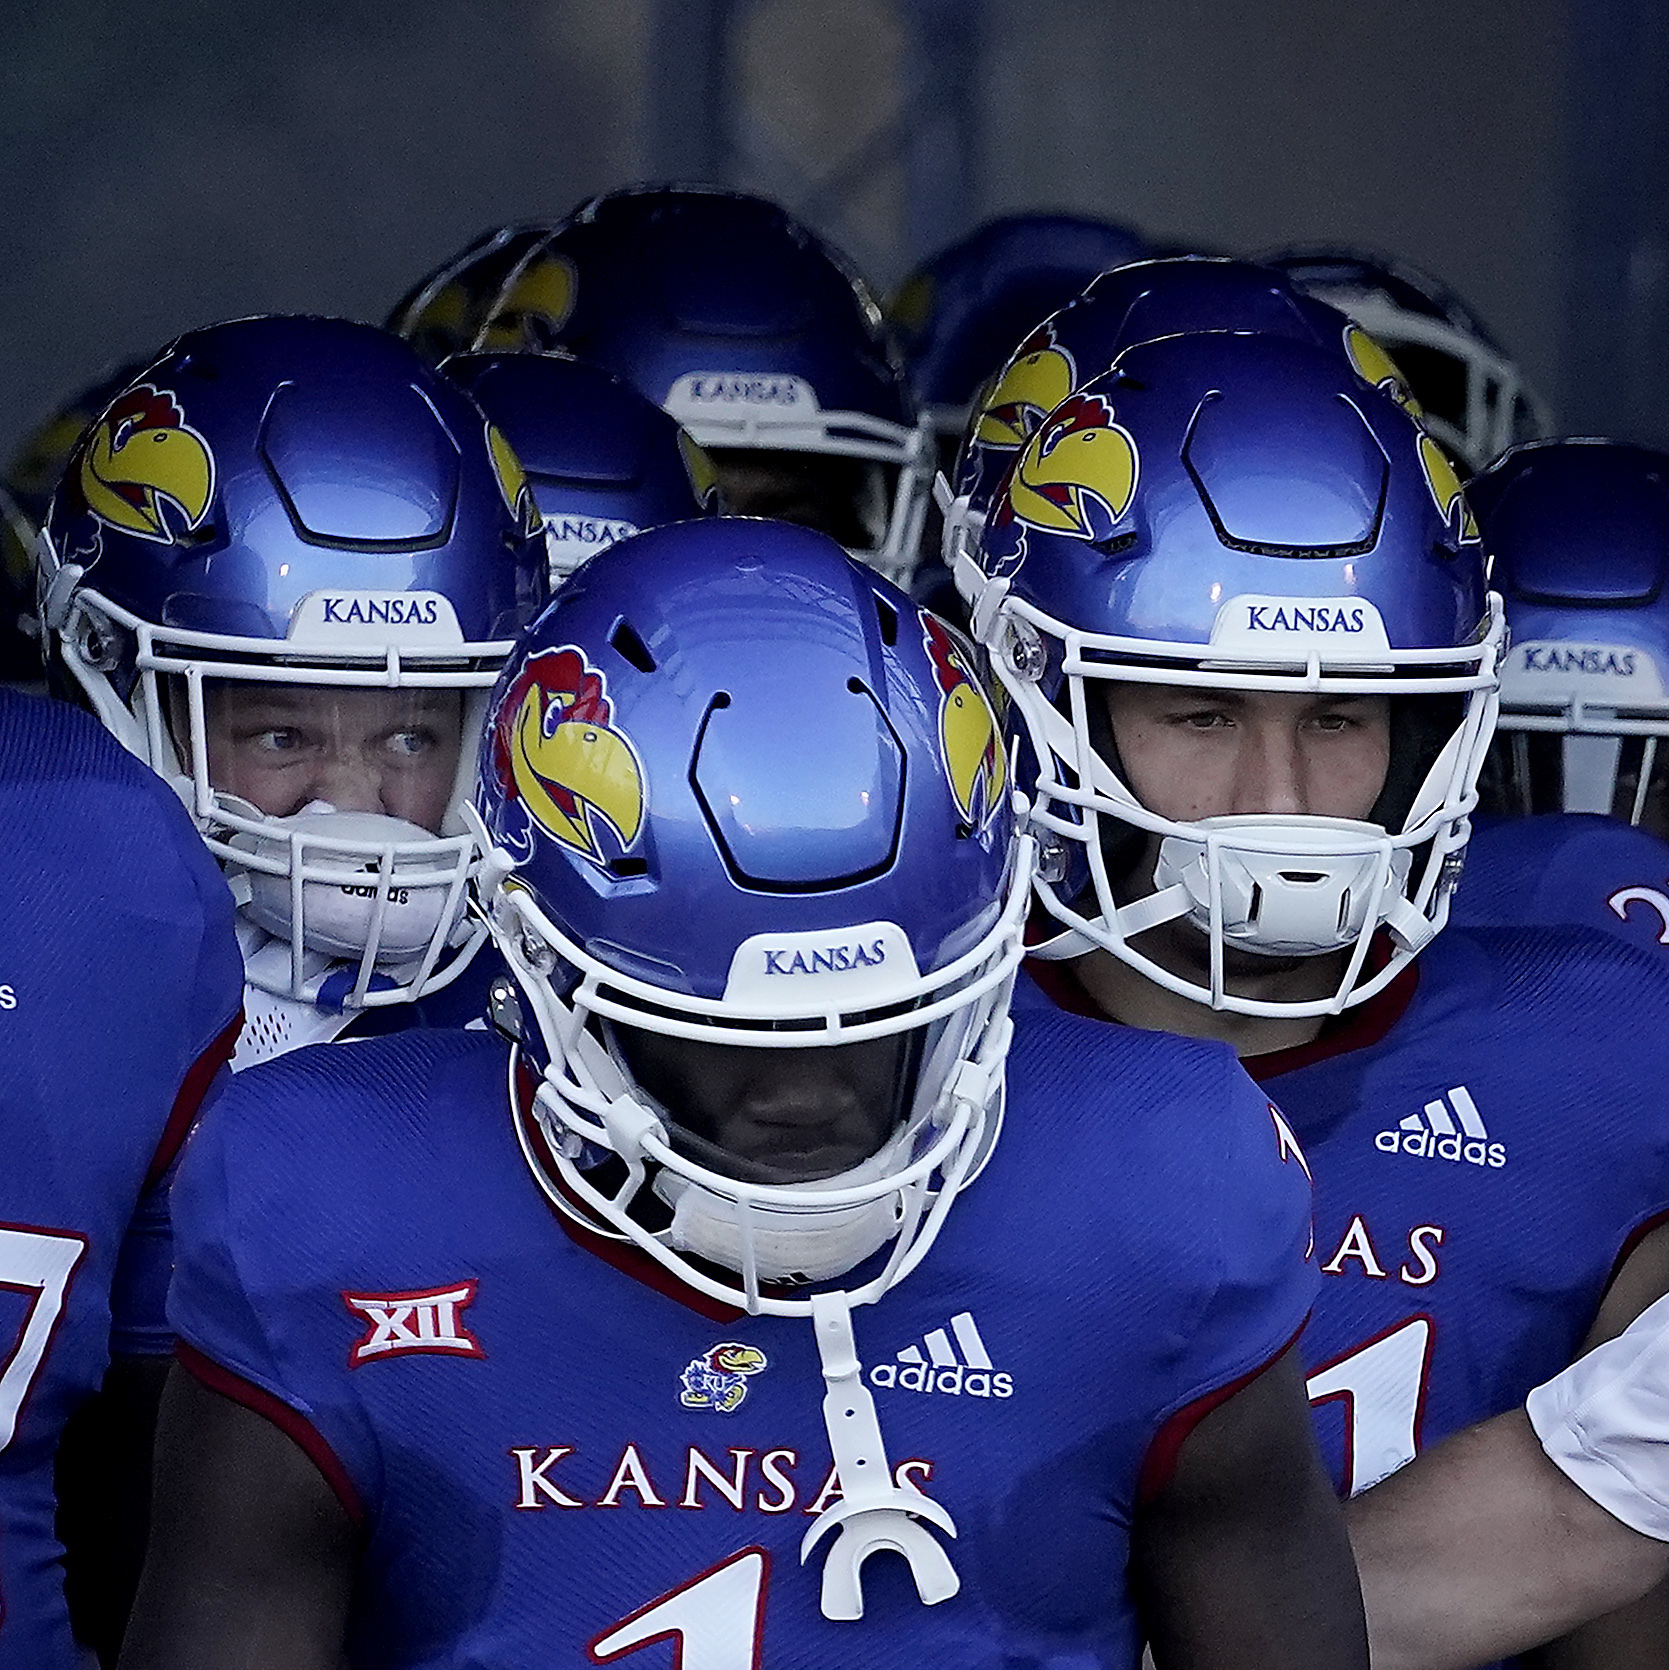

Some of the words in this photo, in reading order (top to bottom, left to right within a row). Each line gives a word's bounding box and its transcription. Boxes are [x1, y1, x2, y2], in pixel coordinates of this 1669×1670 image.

[545, 518, 635, 544] ANSAS
[322, 599, 437, 624] KANSAS
[1246, 606, 1366, 633] KANSAS
[1523, 648, 1636, 678] KANSAS
[763, 939, 886, 977] KANSAS
[1374, 1127, 1507, 1167] adidas
[870, 1361, 1015, 1399] adidas
